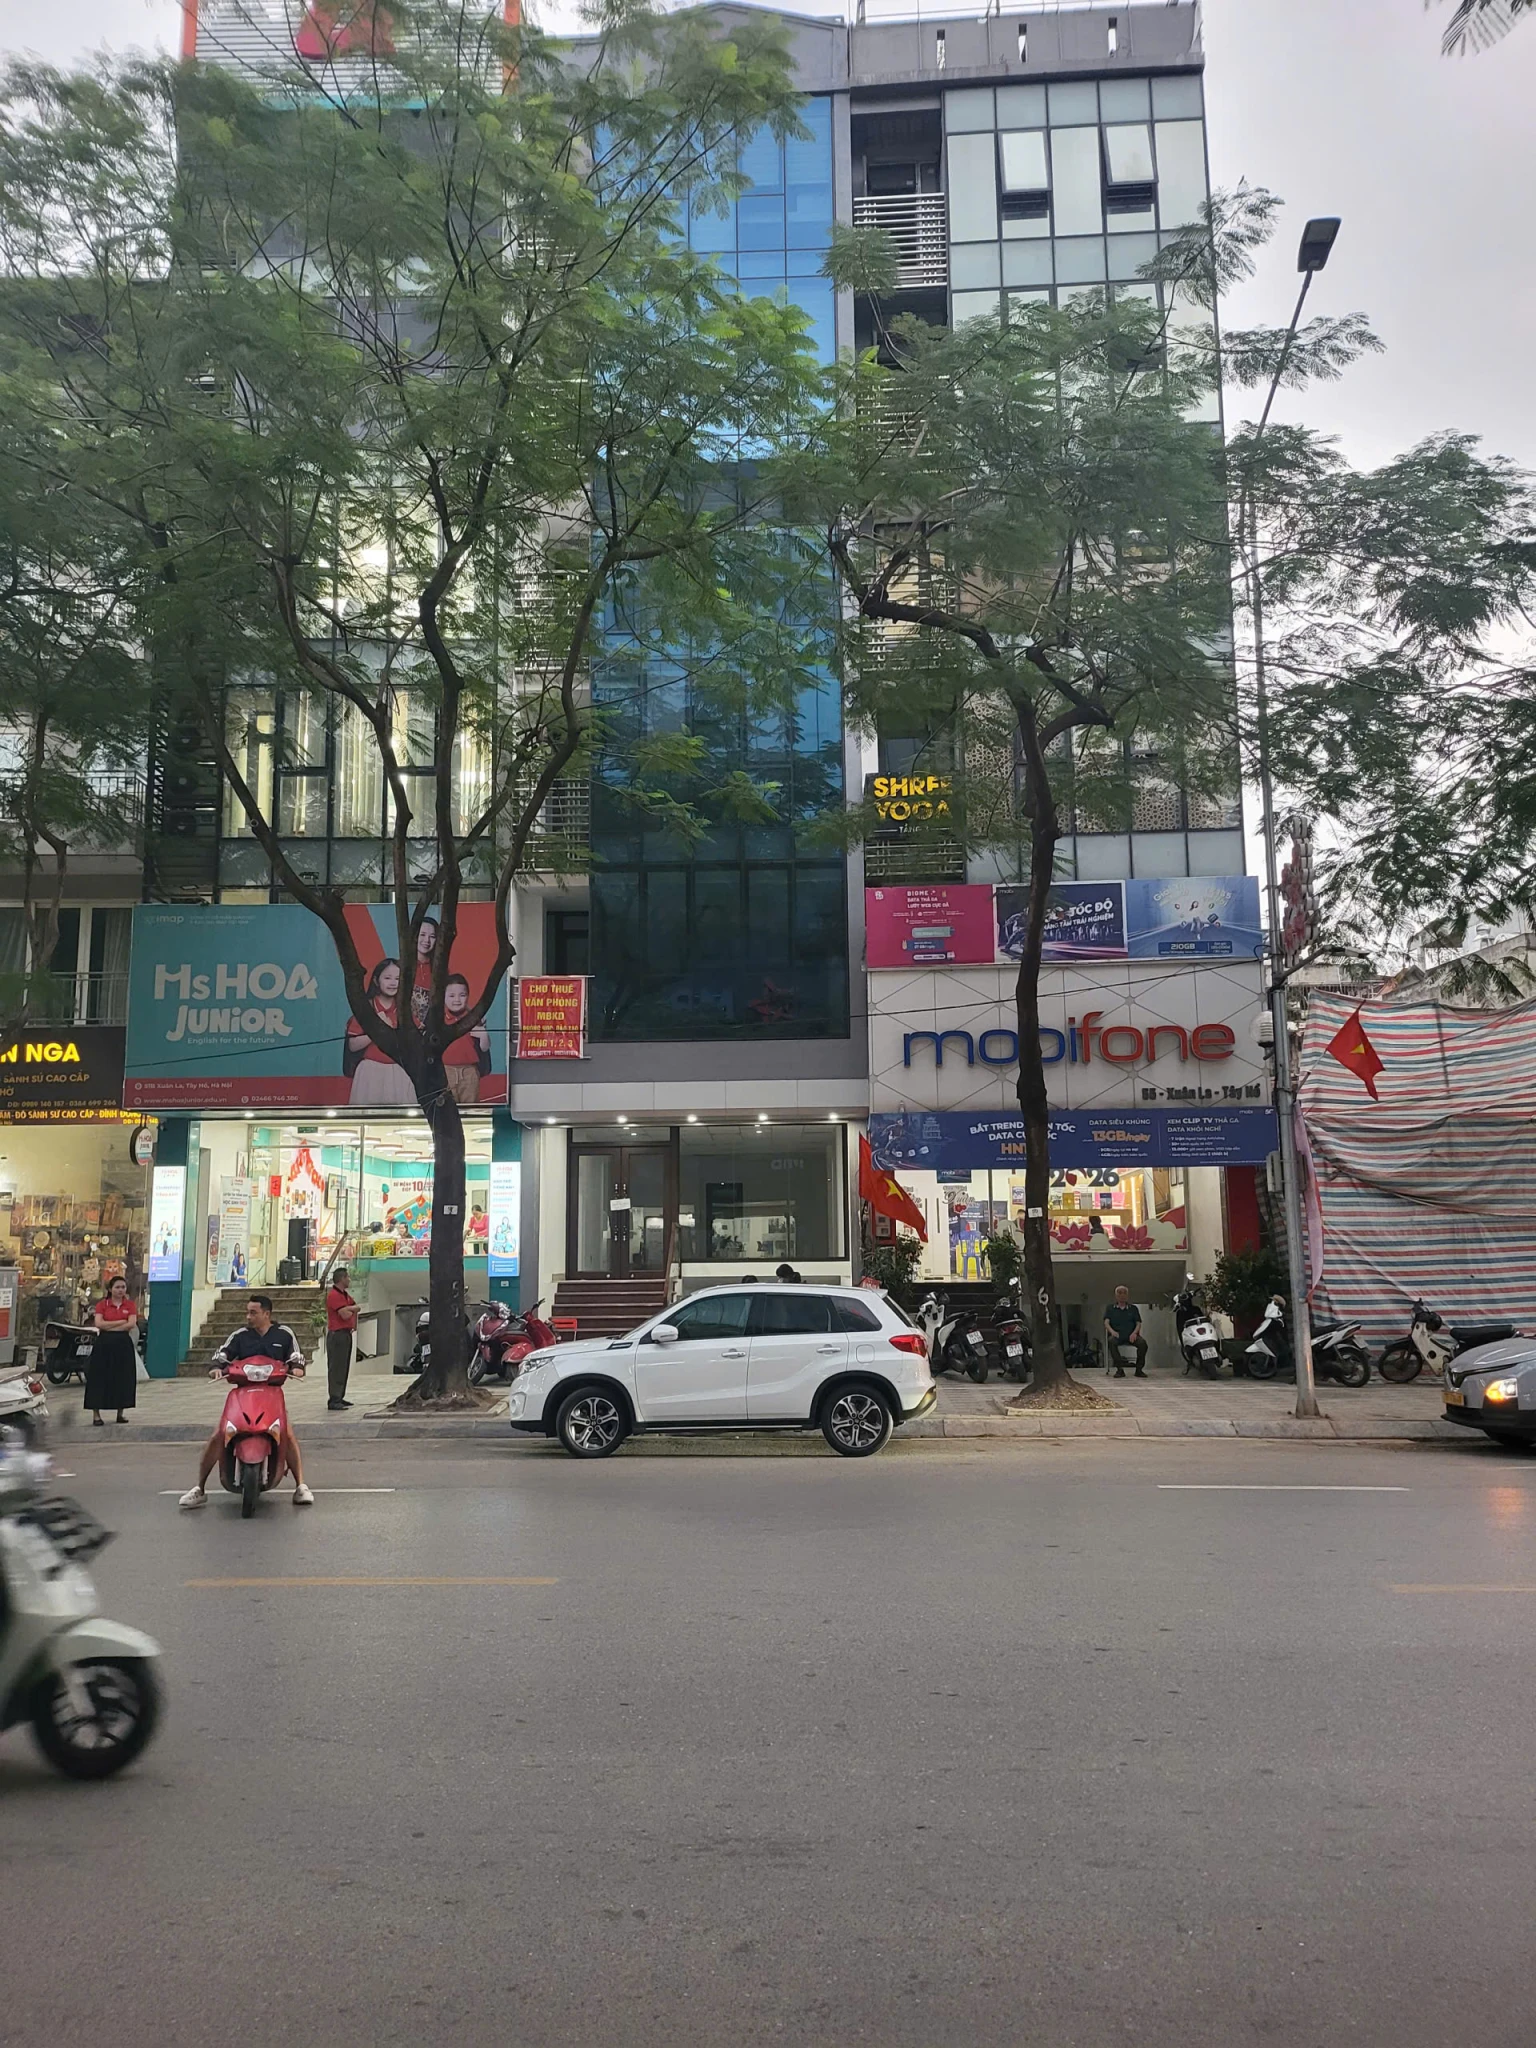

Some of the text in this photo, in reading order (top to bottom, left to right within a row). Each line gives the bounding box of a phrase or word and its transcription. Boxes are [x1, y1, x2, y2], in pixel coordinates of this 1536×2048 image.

[529, 983, 574, 993] CHO THUÊ
[546, 997, 578, 1006] PHÒNG
[26, 1042, 81, 1063] NGA
[46, 1074, 68, 1083] CAO
[1197, 1087, 1211, 1099] La
[61, 1110, 77, 1118] CAO
[991, 1121, 1024, 1131] TREND
[989, 1132, 1014, 1141] DATA
[412, 1181, 423, 1192] 10
